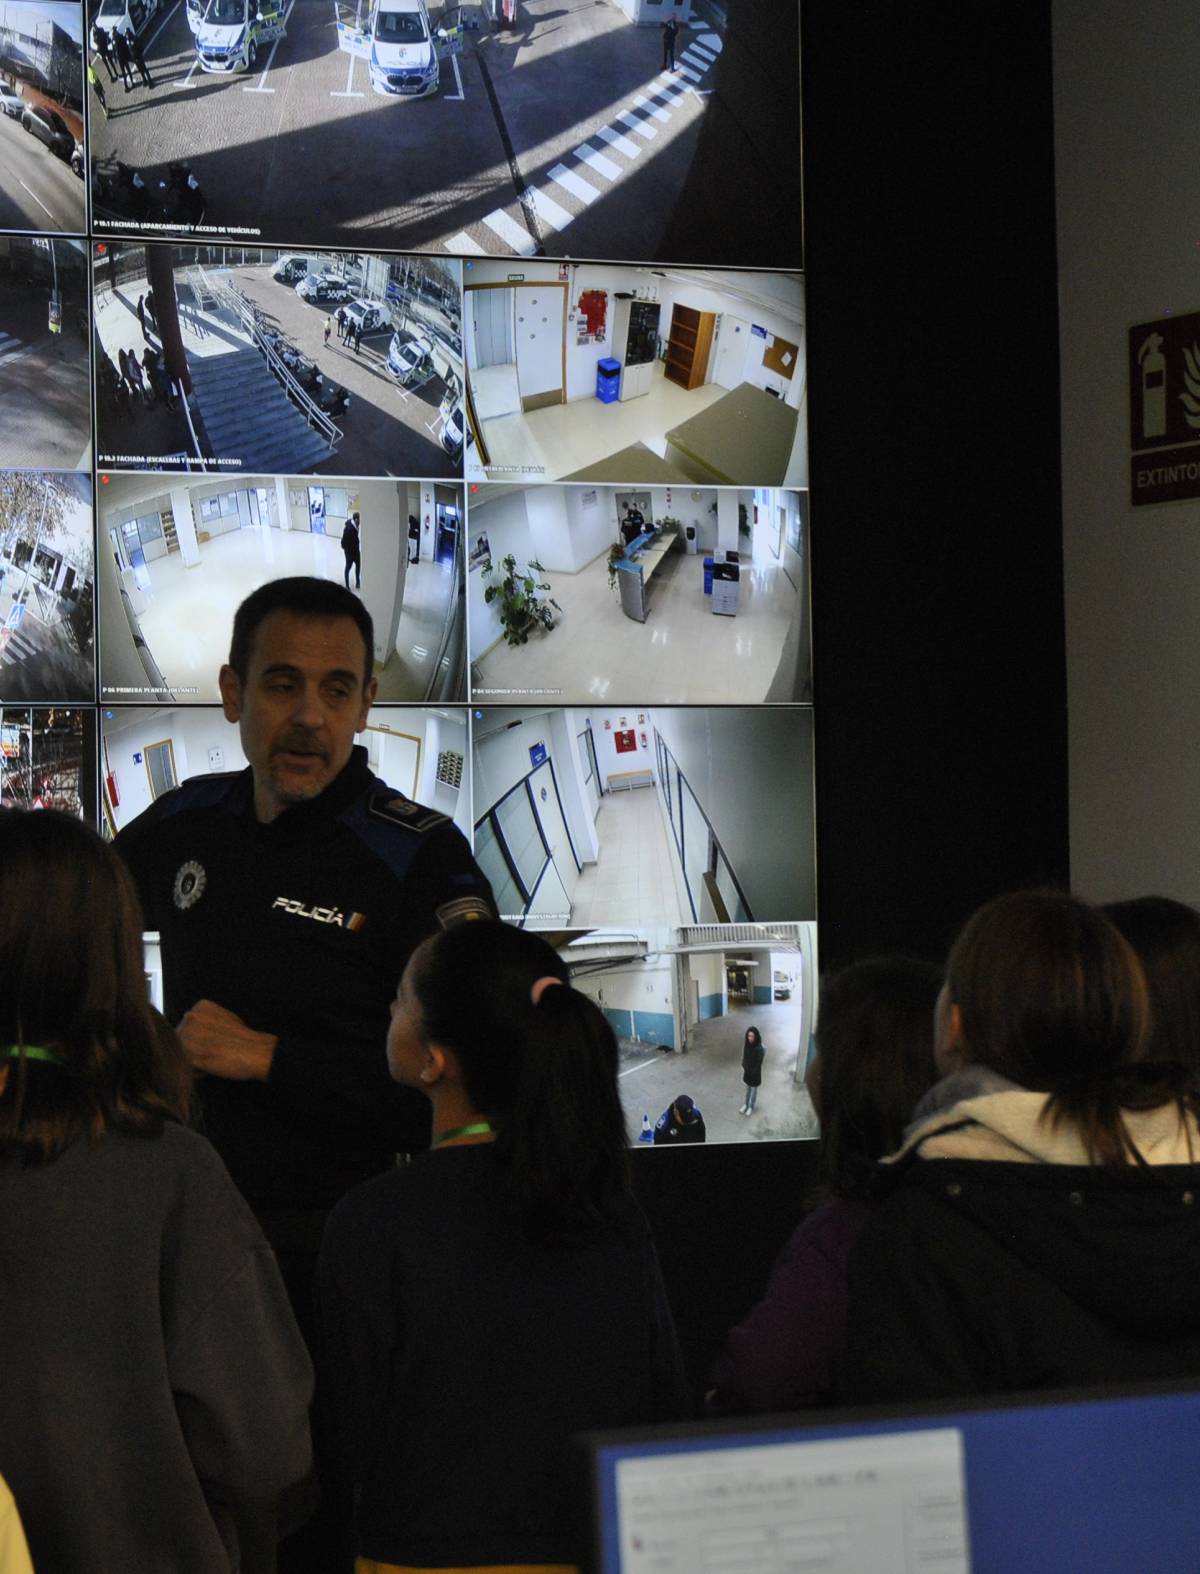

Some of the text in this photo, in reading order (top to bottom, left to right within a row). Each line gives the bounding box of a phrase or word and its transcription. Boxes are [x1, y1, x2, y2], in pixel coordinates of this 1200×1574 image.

[111, 221, 140, 230] FACHADA
[195, 225, 217, 233] ACCESO
[116, 455, 146, 463] FACHADA
[1137, 462, 1200, 488] EXTINTO
[272, 896, 344, 927] POLICÍA
